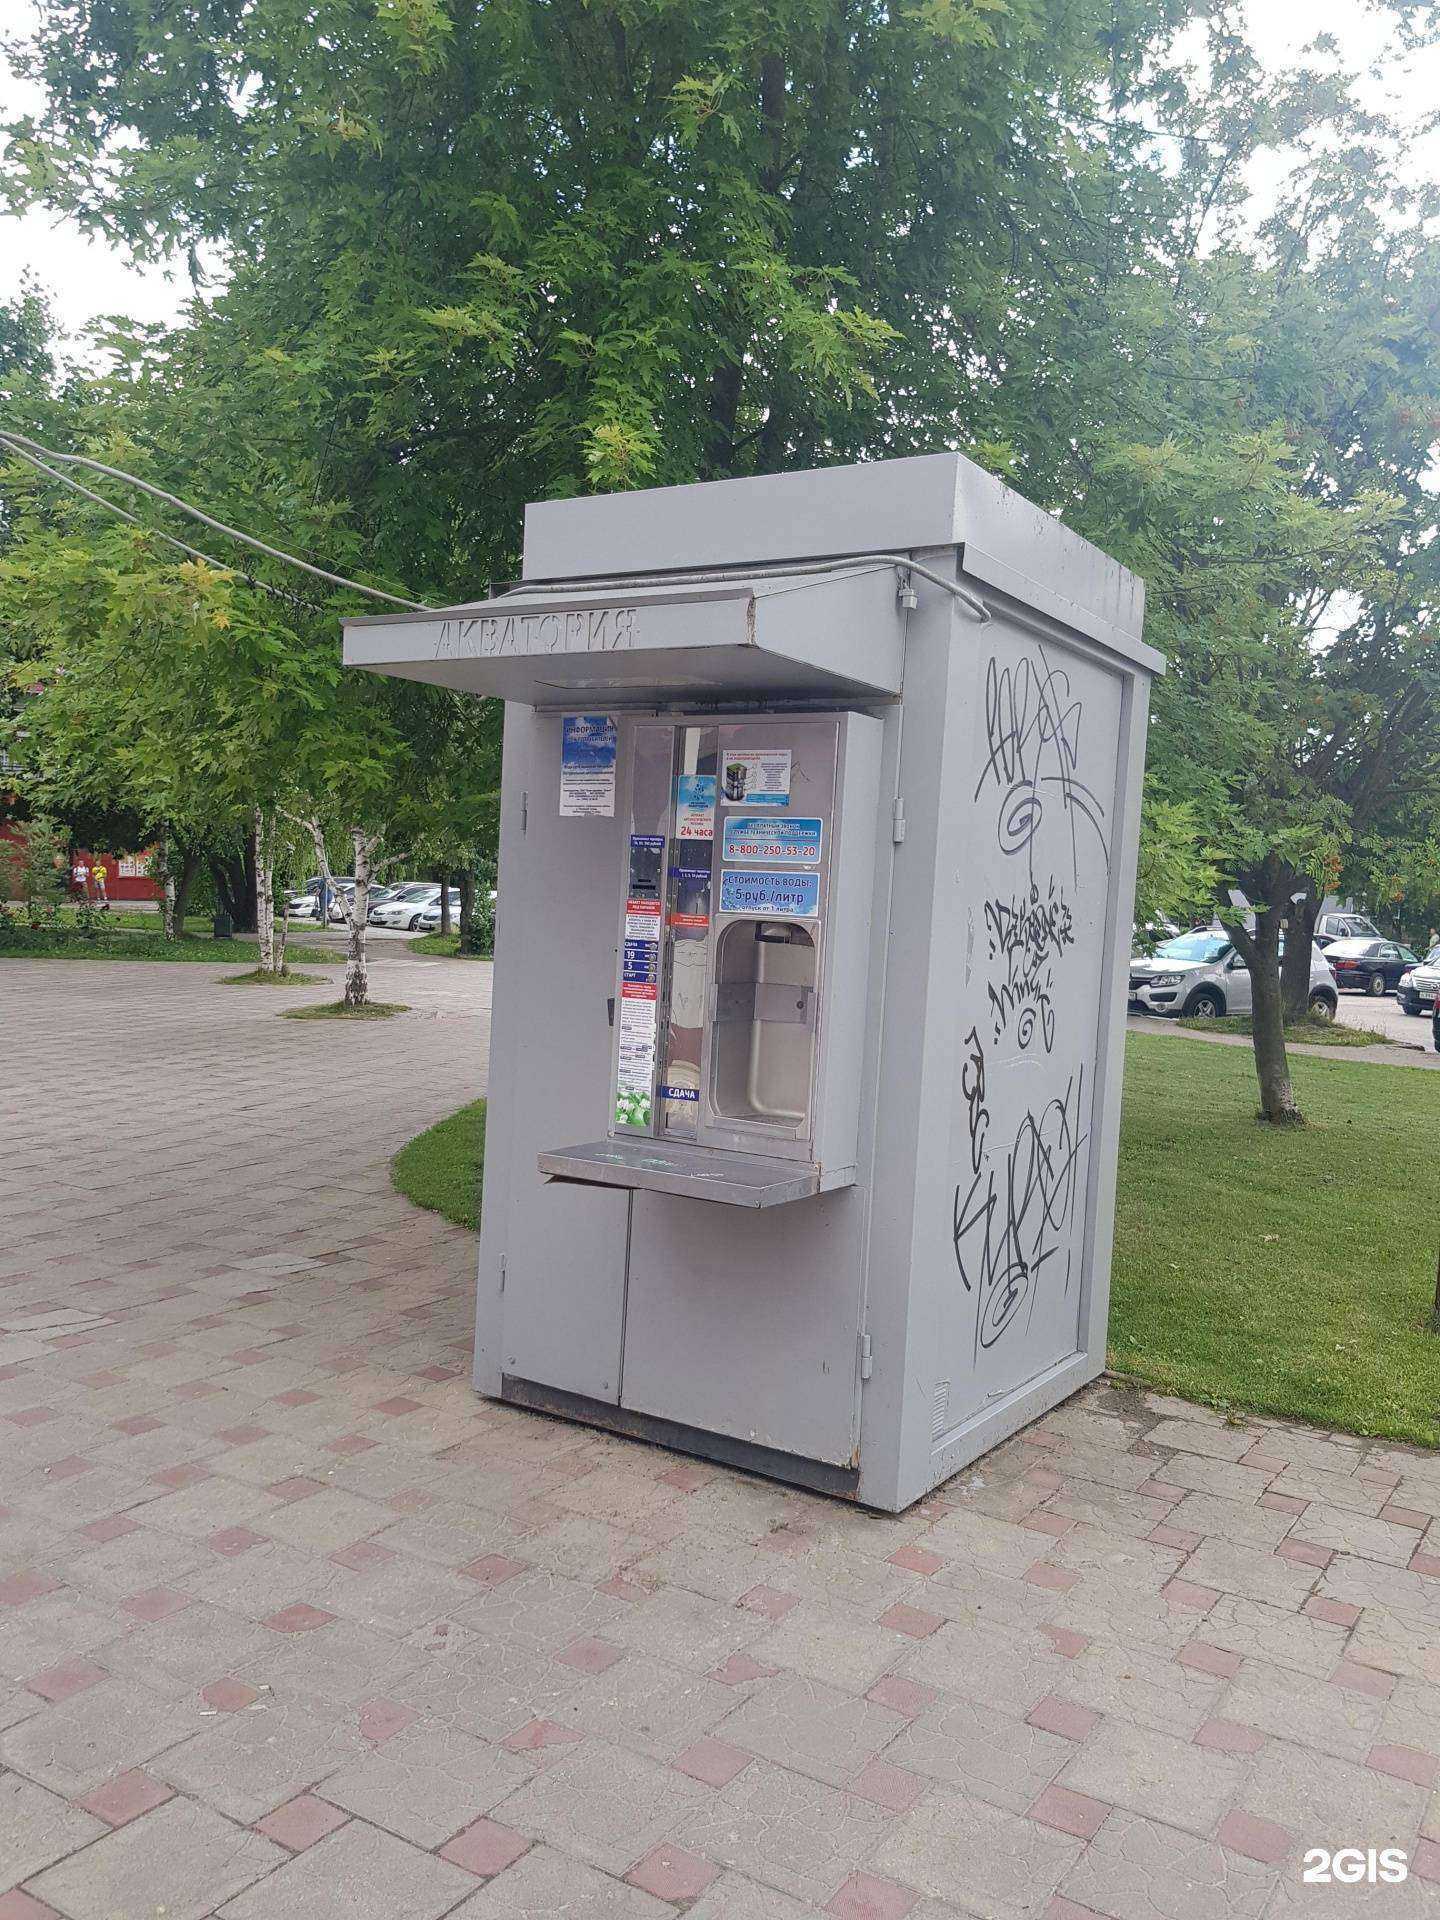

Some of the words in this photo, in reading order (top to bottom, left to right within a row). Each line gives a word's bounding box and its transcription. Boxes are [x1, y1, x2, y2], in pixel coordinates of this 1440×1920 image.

[434, 608, 637, 659] АКВАТОРИЯ
[681, 826, 692, 836] 24
[694, 829, 713, 837] часа
[729, 844, 816, 857] 8-800-250-53-20
[728, 875, 781, 886] СТОИМОСТЬ
[782, 878, 812, 888] ВОДЫ:
[745, 889, 804, 906] руб./литр
[627, 950, 635, 960] 19
[627, 961, 633, 970] 5
[668, 1088, 696, 1099] СДАЧА
